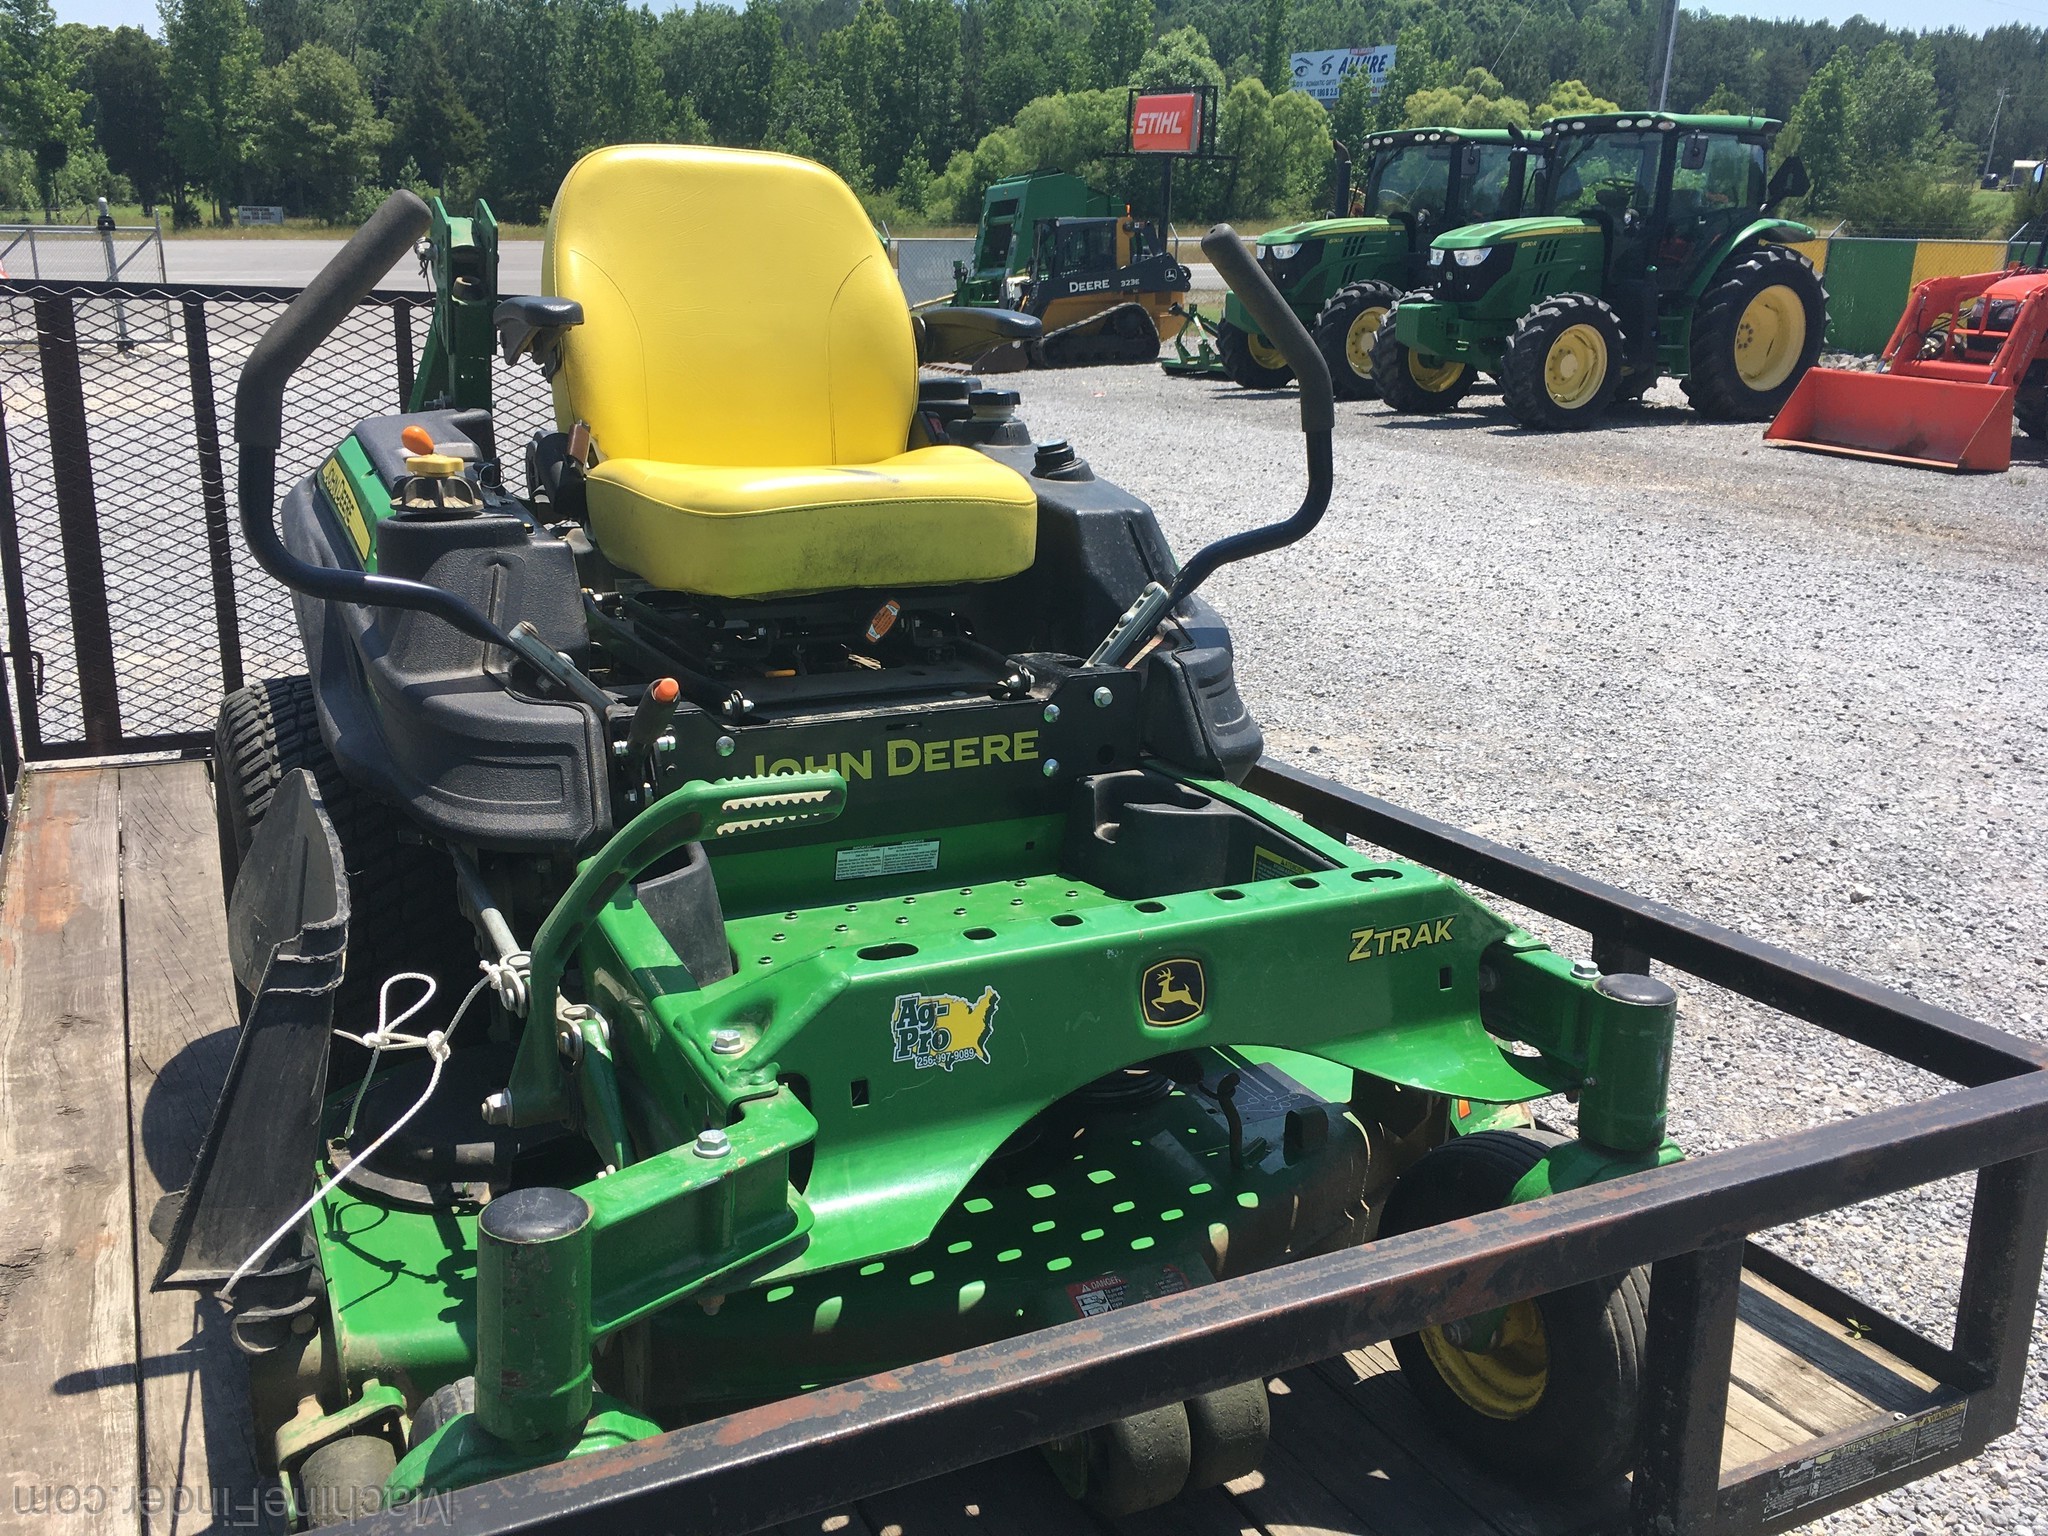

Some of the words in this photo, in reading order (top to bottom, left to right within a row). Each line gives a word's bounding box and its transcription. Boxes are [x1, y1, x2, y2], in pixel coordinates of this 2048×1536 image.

[1136, 111, 1182, 135] STIHL
[1069, 279, 1110, 293] DEERE
[1120, 278, 1140, 288] 323E
[886, 729, 1040, 778] DEERE
[1348, 916, 1456, 963] ZTRAK
[896, 996, 949, 1032] Ag-
[894, 1027, 951, 1060] Pro
[1090, 1275, 1122, 1290] DANGER
